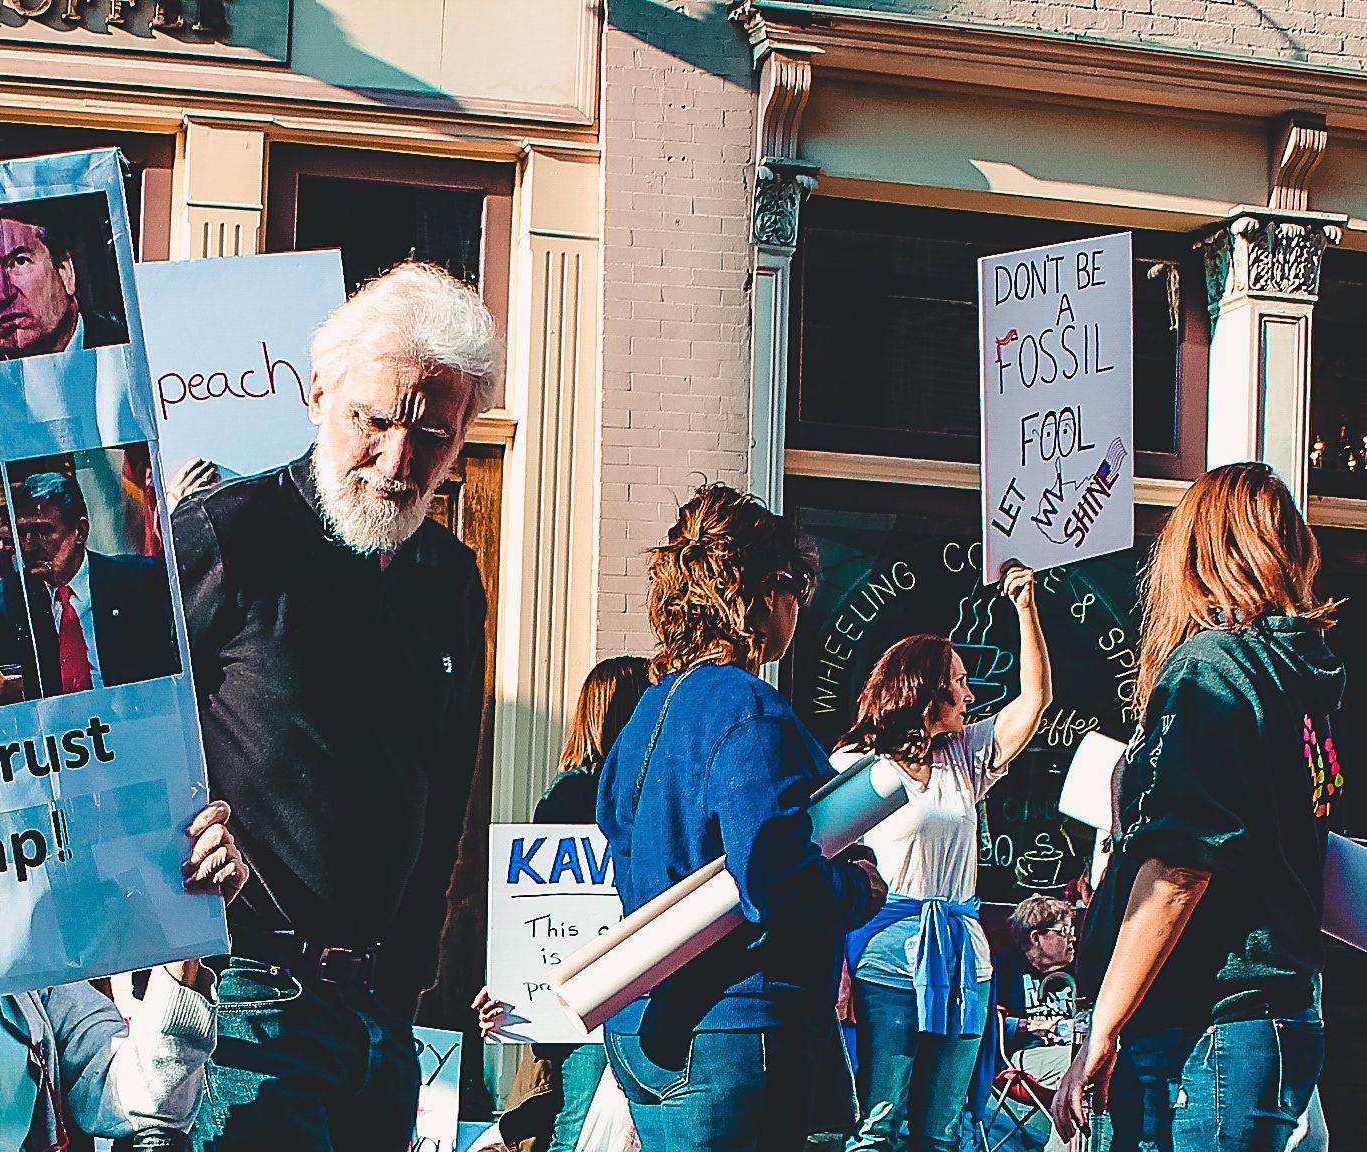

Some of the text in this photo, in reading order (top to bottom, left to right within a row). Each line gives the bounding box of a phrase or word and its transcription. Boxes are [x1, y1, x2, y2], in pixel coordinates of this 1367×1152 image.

[995, 250, 1106, 306] DON'T BE
[1055, 293, 1075, 326] A
[157, 341, 309, 420] peach
[995, 322, 1114, 394] FOSSIL
[1021, 405, 1095, 466] FOOL
[991, 477, 1026, 537] LET
[1031, 473, 1064, 527] WV
[1063, 458, 1120, 549] SHINE
[812, 561, 916, 714] WHEELING
[1070, 593, 1096, 624] &
[524, 913, 579, 938] This
[540, 947, 562, 966] is
